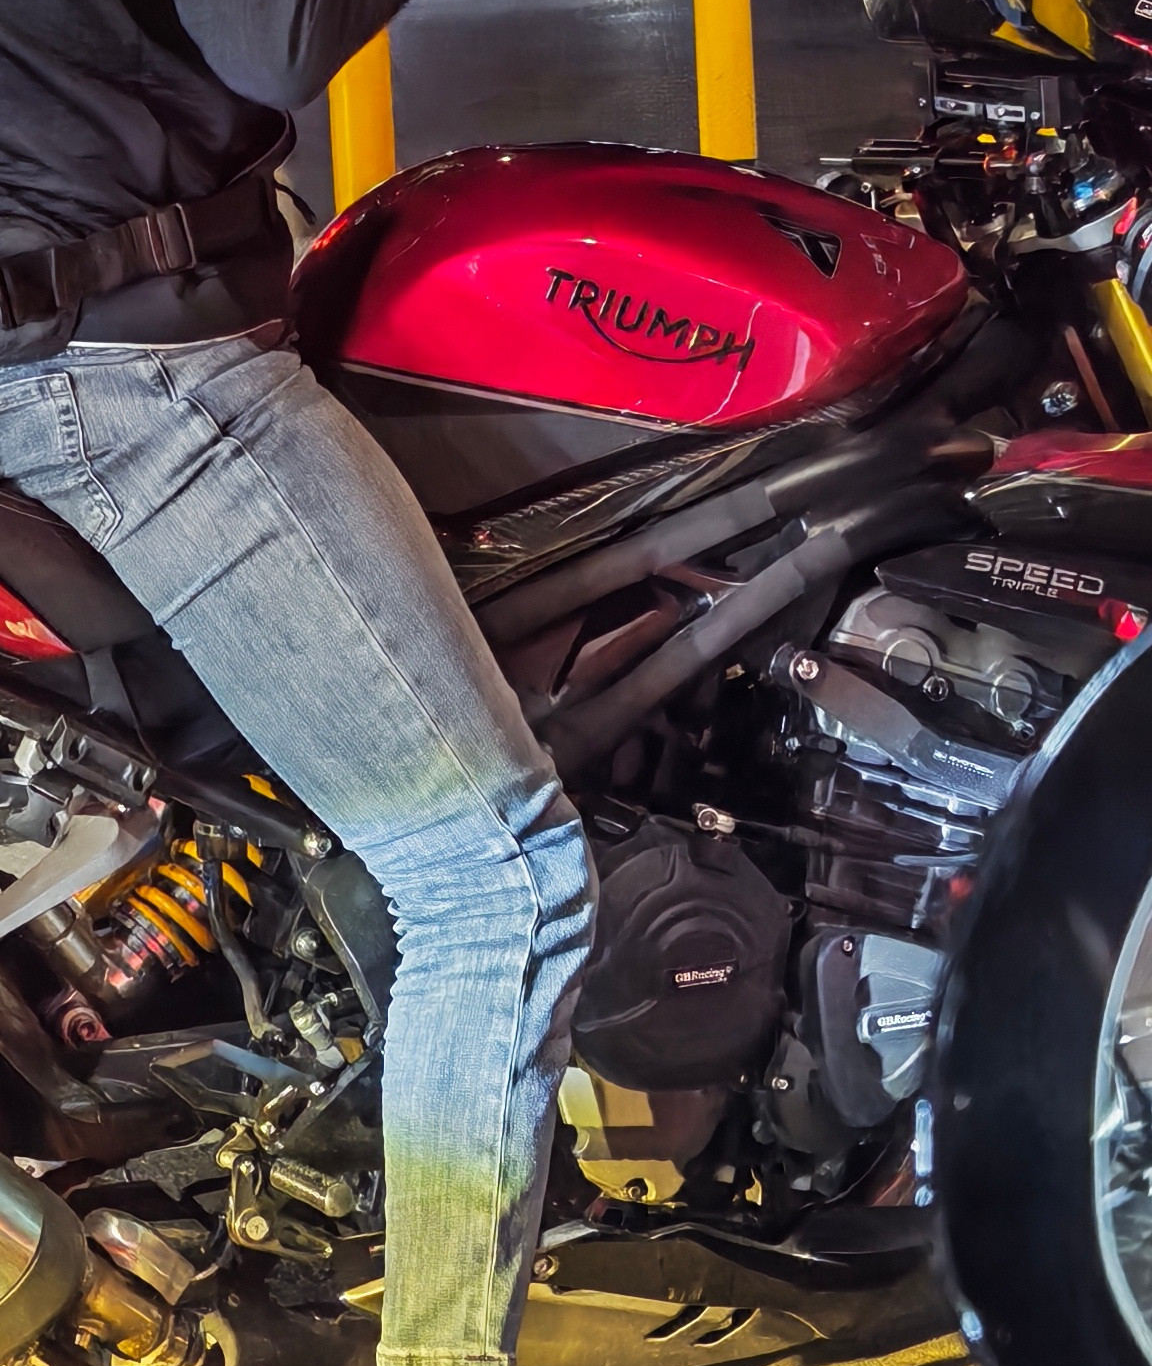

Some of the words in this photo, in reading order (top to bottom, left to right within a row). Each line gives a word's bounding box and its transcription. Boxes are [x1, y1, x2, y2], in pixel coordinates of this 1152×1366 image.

[545, 266, 756, 373] TRIUMPH
[964, 551, 1105, 596] SPEED
[991, 575, 1058, 599] TRIPLE
